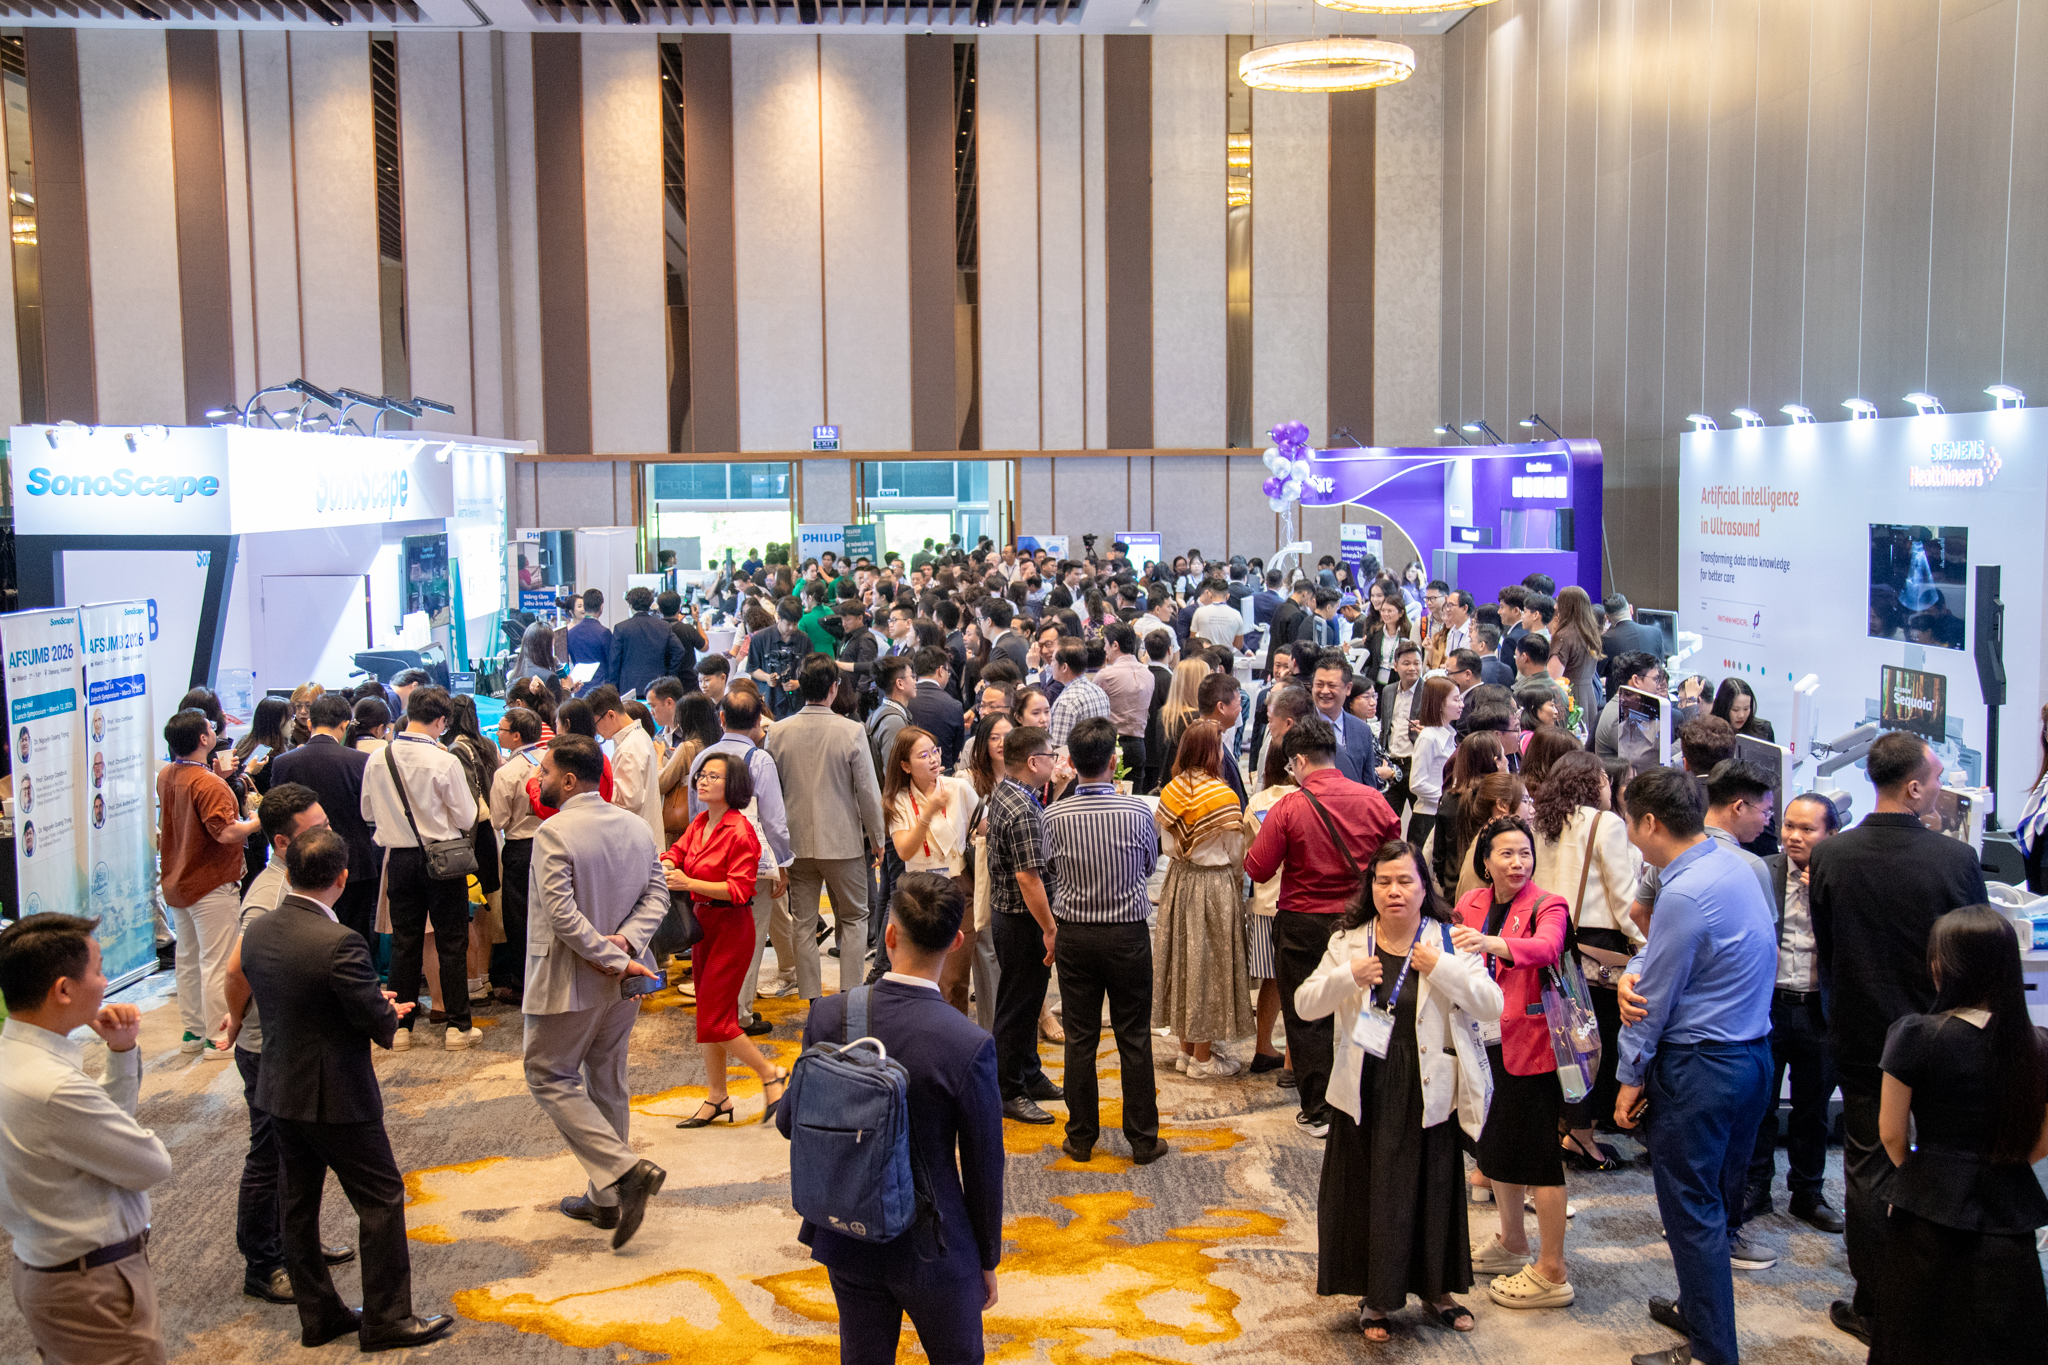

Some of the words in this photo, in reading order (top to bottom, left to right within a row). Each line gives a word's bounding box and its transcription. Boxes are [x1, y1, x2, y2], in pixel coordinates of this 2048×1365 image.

[1931, 440, 1984, 461] SIEMENS
[26, 467, 219, 503] SonoScape
[1909, 464, 1984, 487] Healthineers
[316, 462, 408, 519] SonoScape
[1701, 485, 1740, 510] Artificial
[1742, 485, 1799, 513] intelligence
[1701, 515, 1708, 534] in
[1711, 517, 1760, 537] Ultrasound
[1701, 551, 1733, 568] Transforming
[1734, 554, 1747, 566] data
[1747, 555, 1758, 567] into
[1759, 556, 1791, 573] knowledge
[1708, 570, 1723, 581] better
[1723, 573, 1735, 583] care
[50, 617, 74, 626] SonoScape
[124, 607, 145, 616] SonoScape
[89, 635, 123, 655] AFSUMB
[125, 632, 144, 648] 2026
[9, 647, 50, 669] AFSUMB
[52, 643, 73, 661] 2026
